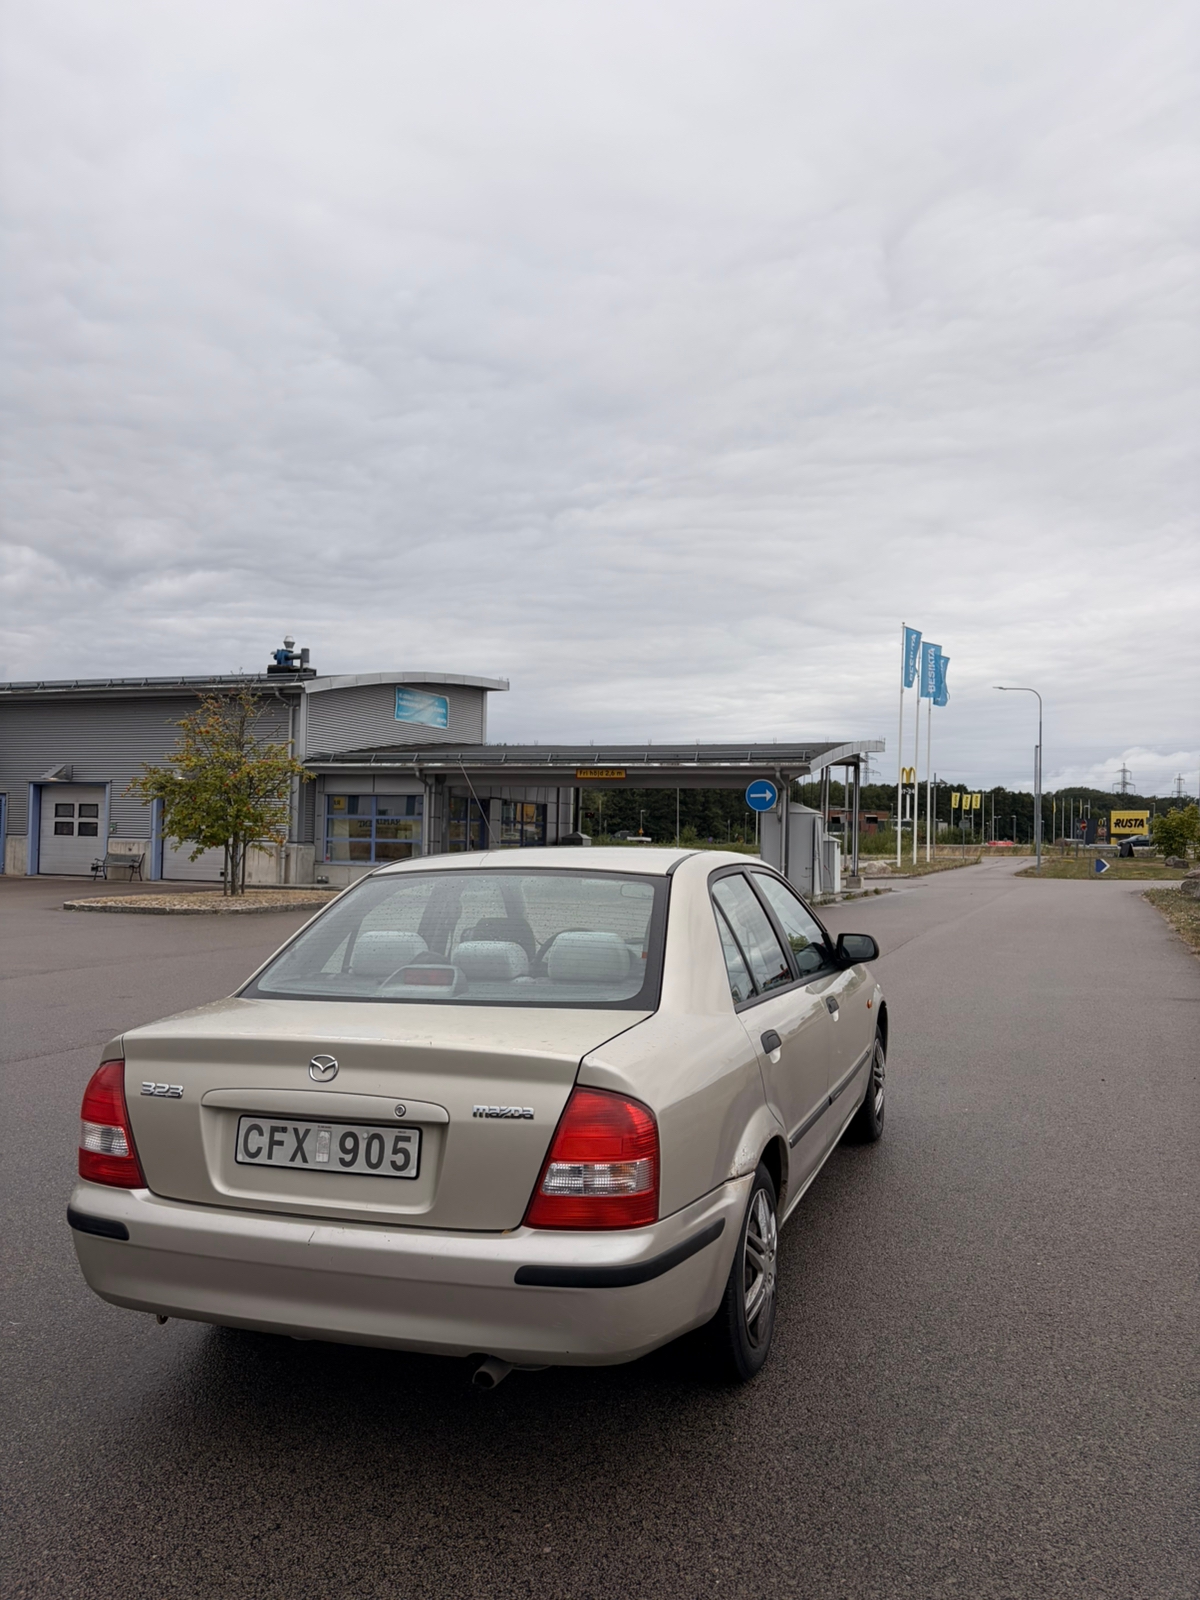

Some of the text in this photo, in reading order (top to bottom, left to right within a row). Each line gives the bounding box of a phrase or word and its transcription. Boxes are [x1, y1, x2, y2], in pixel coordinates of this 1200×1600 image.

[928, 647, 936, 693] BESIKTA
[1113, 818, 1144, 829] RUSTA
[141, 1081, 184, 1099] 323
[242, 1123, 412, 1172] CFX 905
